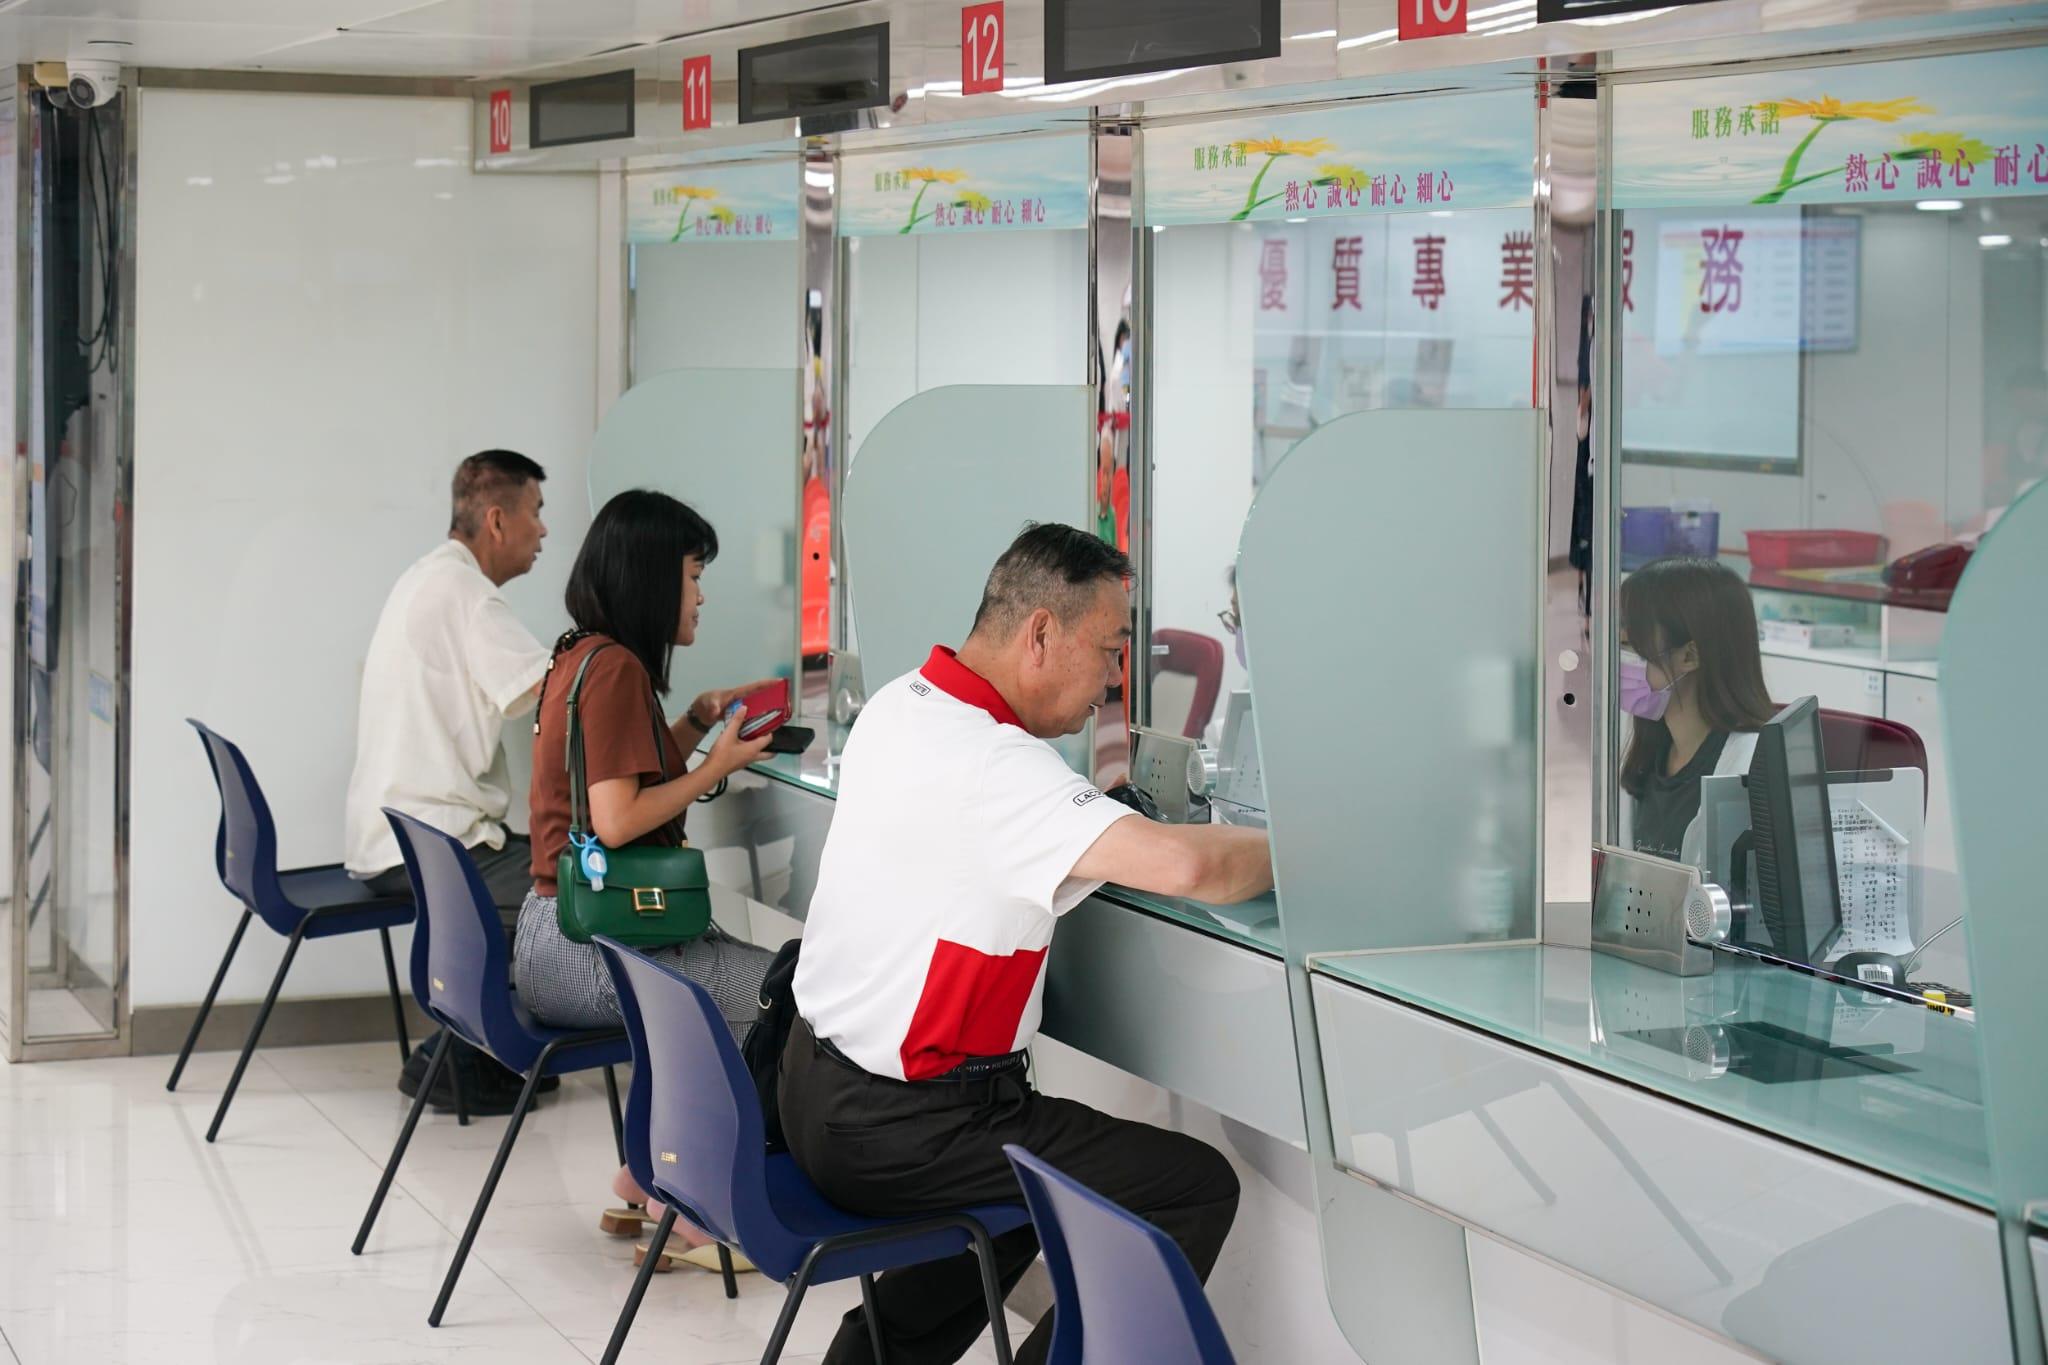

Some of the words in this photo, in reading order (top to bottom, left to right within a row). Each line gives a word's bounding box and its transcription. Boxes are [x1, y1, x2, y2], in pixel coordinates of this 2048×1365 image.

[966, 13, 999, 82] 12
[687, 65, 707, 122] 11
[492, 99, 510, 146] 10
[1691, 104, 1780, 140] 服務承諾
[1193, 141, 1247, 172] 服務承諾
[1845, 152, 1900, 193] 熱心
[1916, 148, 1975, 190] 誠心
[1285, 180, 1318, 212] 熱心
[1327, 176, 1361, 209] 誠心
[1371, 173, 1406, 207] 耐心
[1416, 170, 1454, 204] 細心
